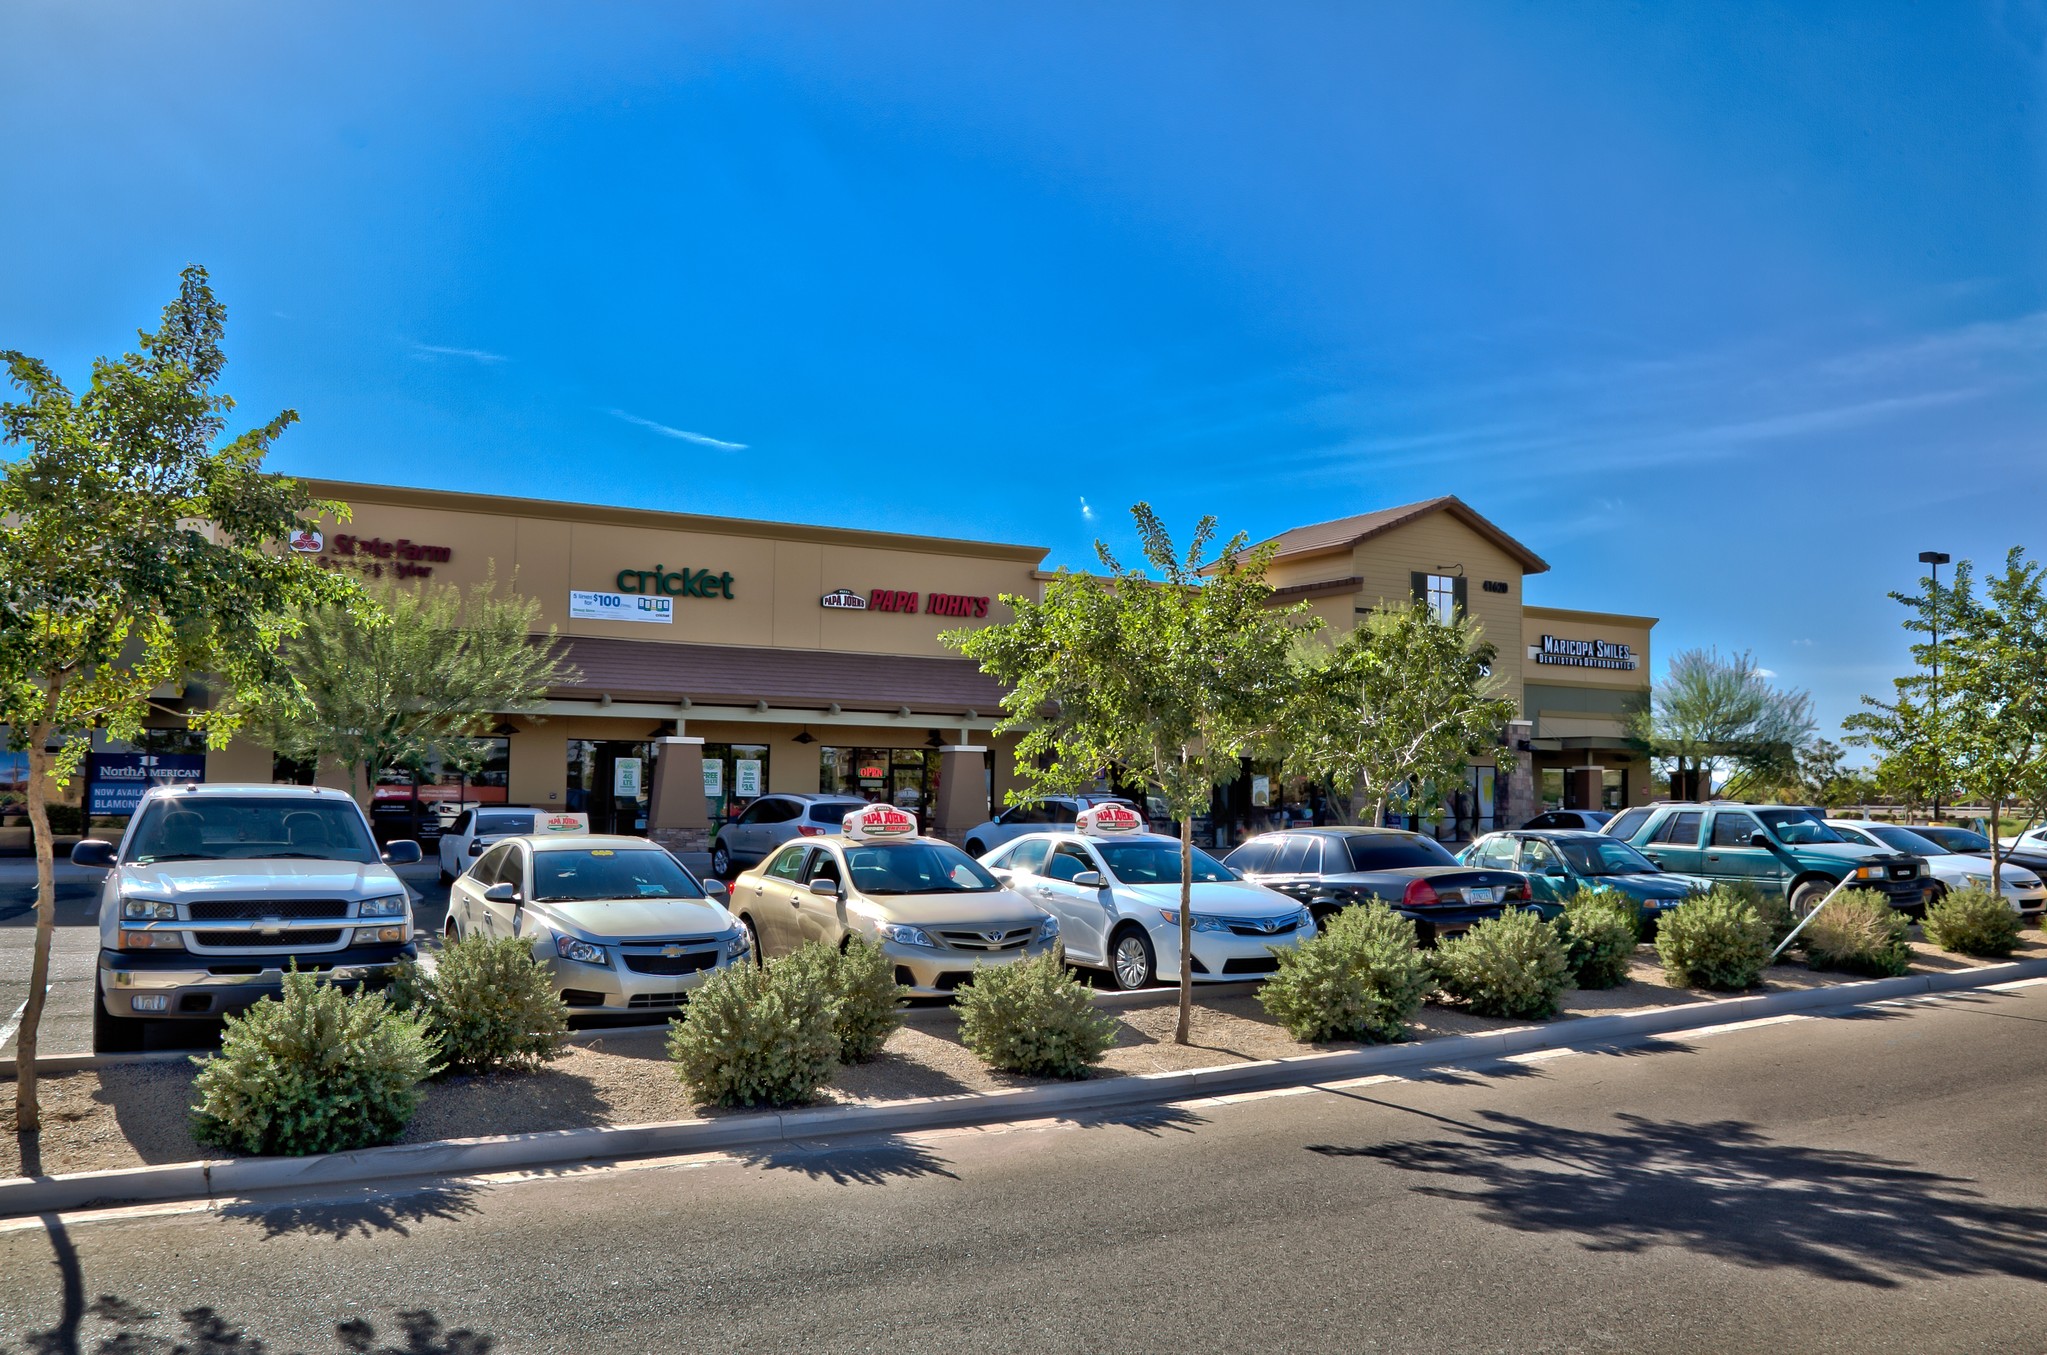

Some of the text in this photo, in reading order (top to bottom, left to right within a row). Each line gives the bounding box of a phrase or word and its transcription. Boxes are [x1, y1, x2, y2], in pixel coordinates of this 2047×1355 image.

[332, 533, 451, 563] State Farm
[390, 561, 433, 580] yler
[616, 564, 735, 600] cricket
[593, 593, 621, 608] $100
[824, 594, 842, 607] PAPA
[868, 588, 991, 618] PAPA JOHN'S
[1542, 635, 1630, 660] MARICOPA SMILES
[1538, 653, 1578, 666] DENTISTRY
[1584, 657, 1635, 671] ORTHODONTICS
[860, 767, 883, 777] OPEN
[94, 788, 147, 797] NOW AVAILA
[741, 783, 754, 791] $35
[864, 811, 883, 824] PAPA
[1097, 809, 1113, 820] PAPA
